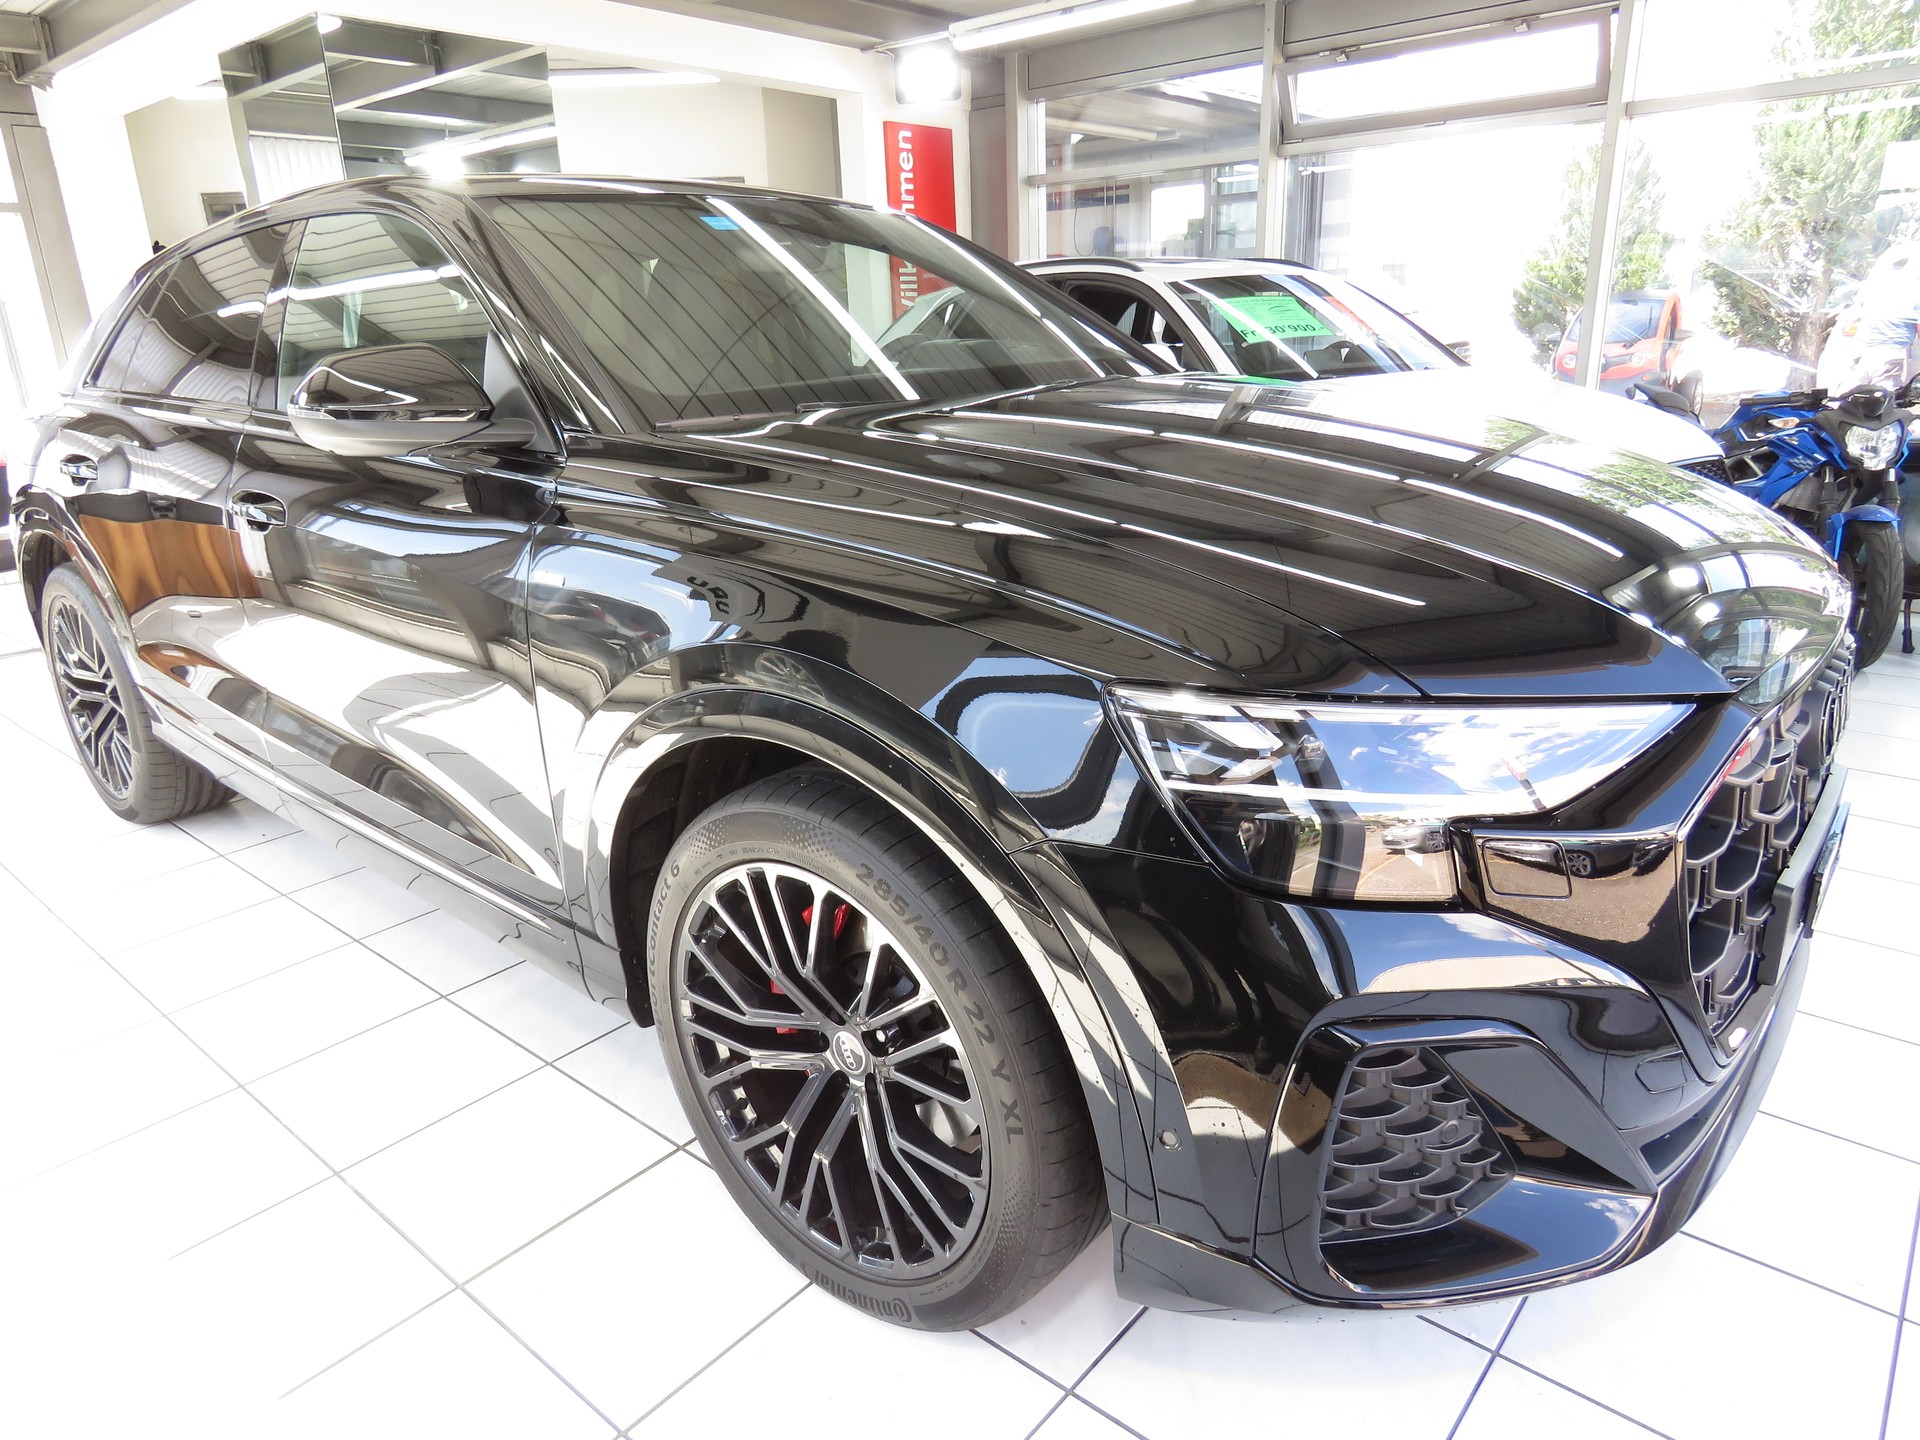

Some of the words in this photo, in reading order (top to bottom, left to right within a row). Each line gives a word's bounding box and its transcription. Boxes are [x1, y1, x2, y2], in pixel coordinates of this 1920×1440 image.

[670, 859, 681, 878] 6
[855, 862, 950, 967] 285/40
[945, 967, 968, 998] R
[963, 1001, 996, 1047] 22
[990, 1058, 1012, 1083] Y
[1000, 1098, 1024, 1145] XL
[814, 1269, 912, 1323] Continental
